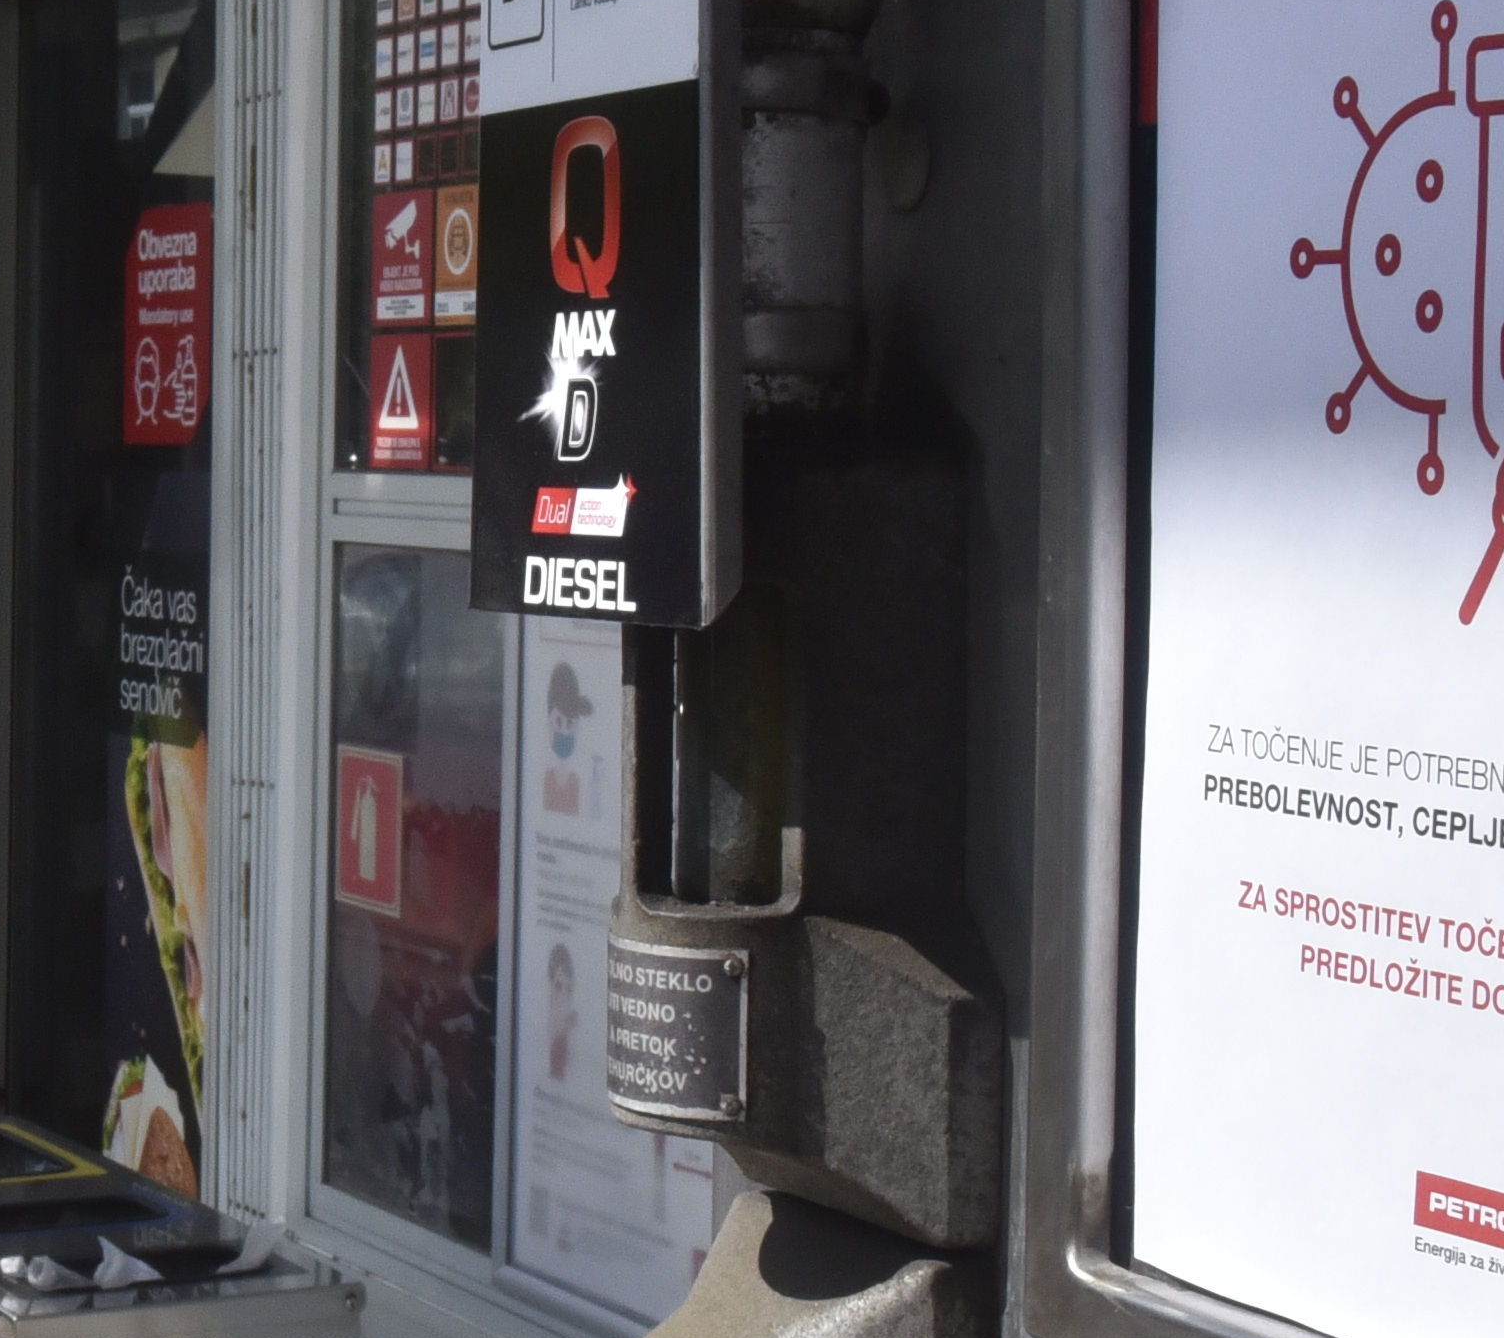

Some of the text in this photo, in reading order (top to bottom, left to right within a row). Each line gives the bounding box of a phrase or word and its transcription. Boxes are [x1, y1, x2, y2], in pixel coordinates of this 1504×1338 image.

[550, 115, 622, 299] Q
[137, 228, 198, 263] Obvezna
[137, 258, 197, 301] uporaba
[551, 309, 616, 358] MAX
[557, 374, 598, 462] D
[538, 495, 571, 524] Dual
[120, 564, 197, 624] Čaka vas
[524, 555, 637, 612] DIESEL
[120, 622, 204, 677] brezplačni
[120, 669, 182, 719] sendvič
[1206, 723, 1235, 756] ZA
[1241, 725, 1344, 772] TOČENJE
[1350, 744, 1380, 777] JE
[1203, 773, 1405, 839] PREBOLEVNOST,
[1238, 880, 1267, 913] ZA
[1273, 886, 1431, 945] SPROSTITEV
[635, 966, 713, 993] STEKLO
[1299, 943, 1464, 1006] PREDLOŽITE
[620, 995, 676, 1023] VEDNO
[1414, 1235, 1466, 1266] Energija
[1469, 1253, 1485, 1271] za
